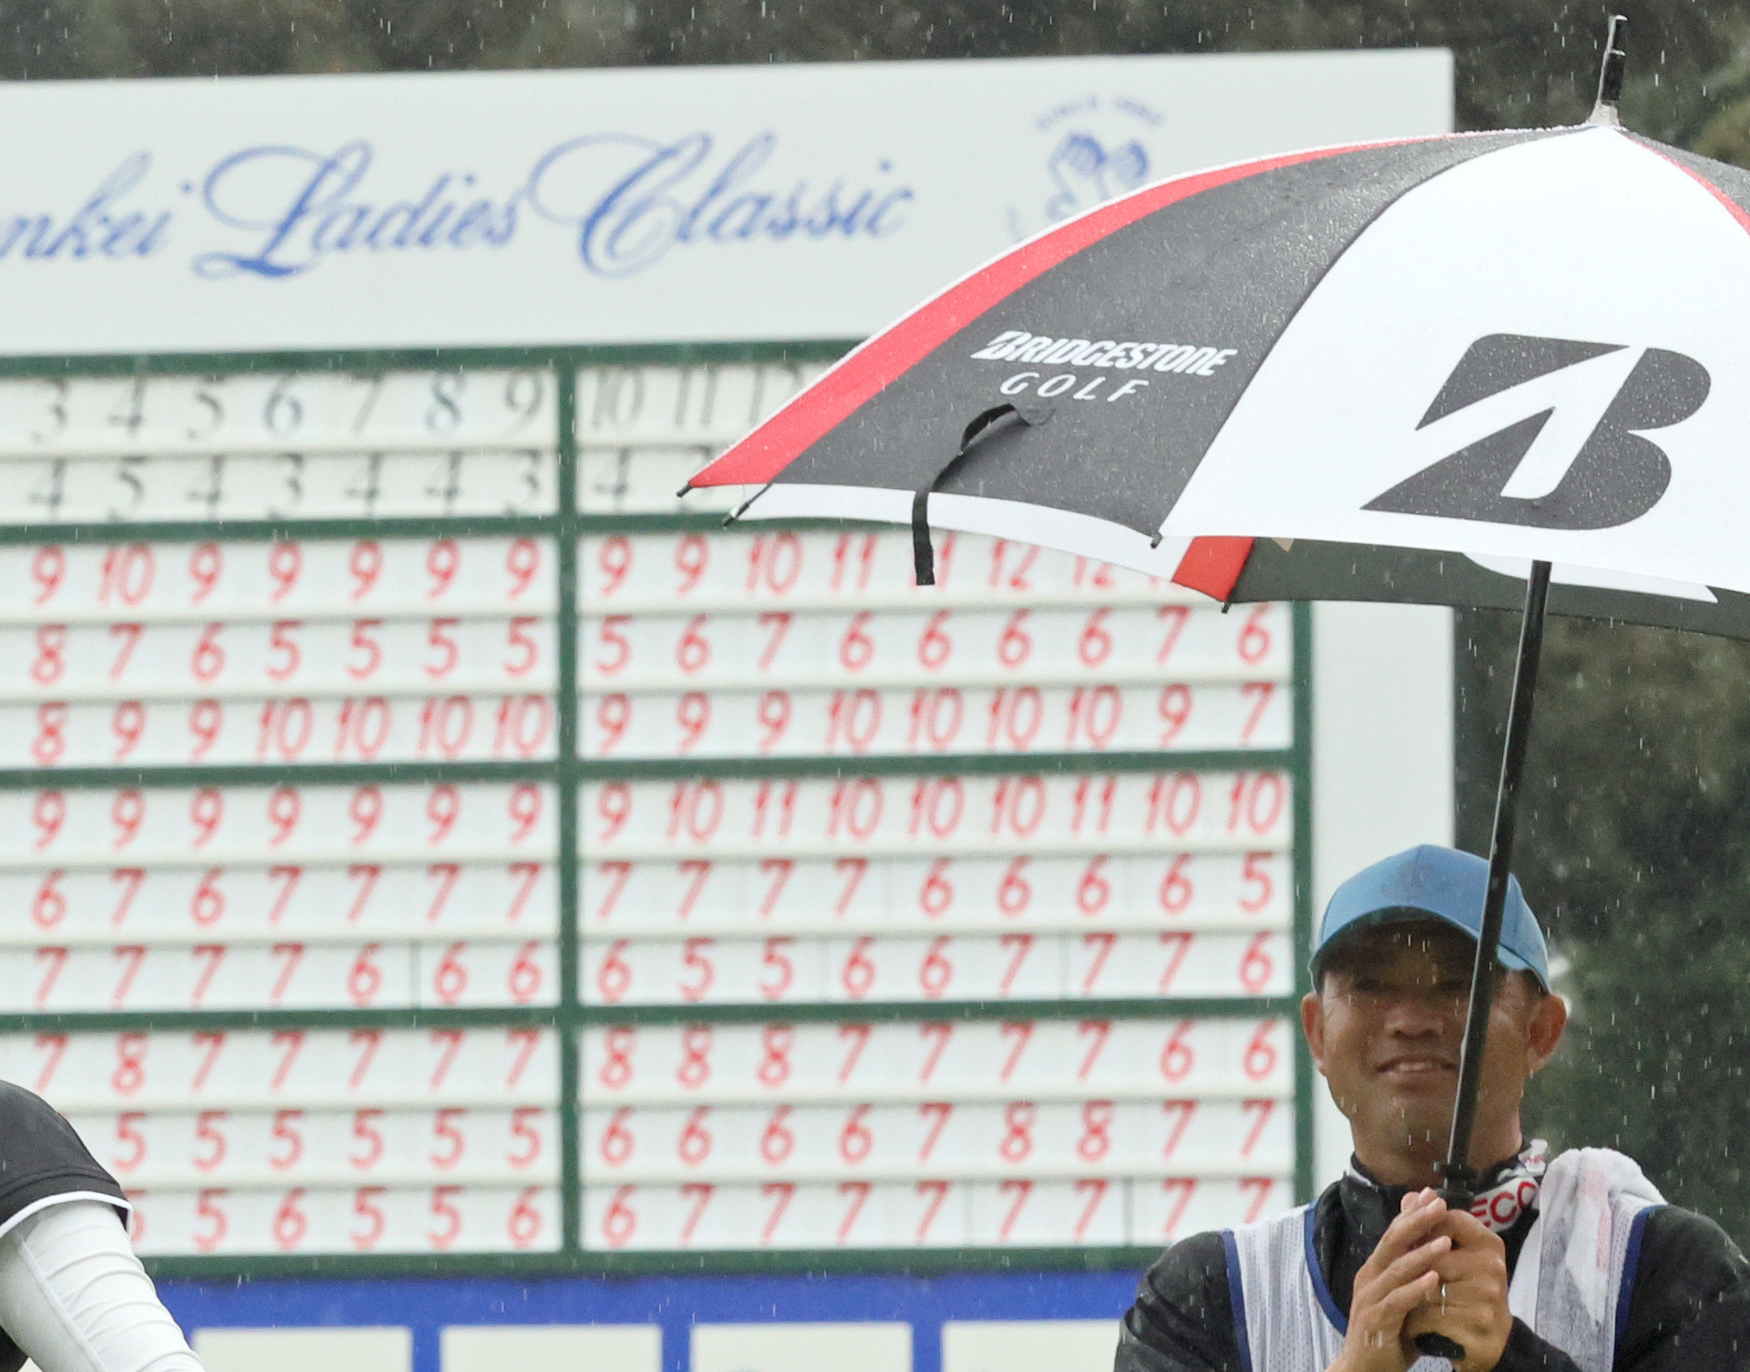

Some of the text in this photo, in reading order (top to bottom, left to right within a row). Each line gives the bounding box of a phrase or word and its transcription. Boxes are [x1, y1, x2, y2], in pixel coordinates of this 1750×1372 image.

[192, 141, 521, 280] Ladies
[528, 131, 915, 280] Classic
[971, 330, 1239, 378] BRIDGESTONE
[1000, 370, 1150, 402] GOLF
[32, 382, 69, 441] 3
[108, 382, 146, 437] 4
[186, 380, 224, 438] 5
[265, 378, 303, 433] 6
[354, 378, 387, 435] 7
[426, 375, 466, 433] 8
[504, 375, 545, 431] 9
[591, 369, 714, 430] 10 11
[26, 458, 67, 522] 4
[108, 457, 146, 520] 5
[185, 456, 225, 520] 4
[266, 454, 303, 519] 3
[341, 453, 384, 520] 4
[422, 452, 463, 519] 4
[504, 449, 542, 518] 3
[33, 546, 64, 604] 9
[101, 547, 154, 605] 10
[190, 544, 221, 602] 9
[270, 544, 301, 600] 9
[350, 542, 382, 599] 9
[427, 541, 460, 597] 9
[507, 539, 539, 600] 9
[600, 538, 633, 595] 9
[675, 535, 708, 595] 9
[748, 533, 802, 595] 10
[832, 535, 877, 589] 11
[32, 624, 66, 685] 8
[110, 622, 142, 677] 7
[193, 622, 224, 680] 6
[268, 620, 301, 680] 5
[349, 619, 381, 680] 5
[426, 618, 458, 678] 5
[506, 616, 538, 677] 5
[598, 605, 1271, 675] 5 6 7 6 6 6 6 7 6
[32, 702, 66, 765] 8
[113, 701, 145, 759] 9
[190, 700, 222, 758] 9
[260, 698, 312, 760] 10
[337, 697, 390, 758] 10
[418, 695, 472, 757] 10
[495, 694, 550, 757] 10
[598, 682, 1276, 753] 9 9 9 10 10 10 10 9 7
[33, 792, 65, 850] 9
[112, 791, 145, 847] 9
[191, 790, 222, 846] 9
[269, 789, 301, 845] 9
[350, 786, 382, 844] 9
[427, 786, 459, 845] 9
[509, 785, 542, 842] 9
[600, 773, 1284, 842] 9 10 11 10 10 10 11 10 10
[602, 1098, 1274, 1166] 6 6 6 6 7 8 8 7 7
